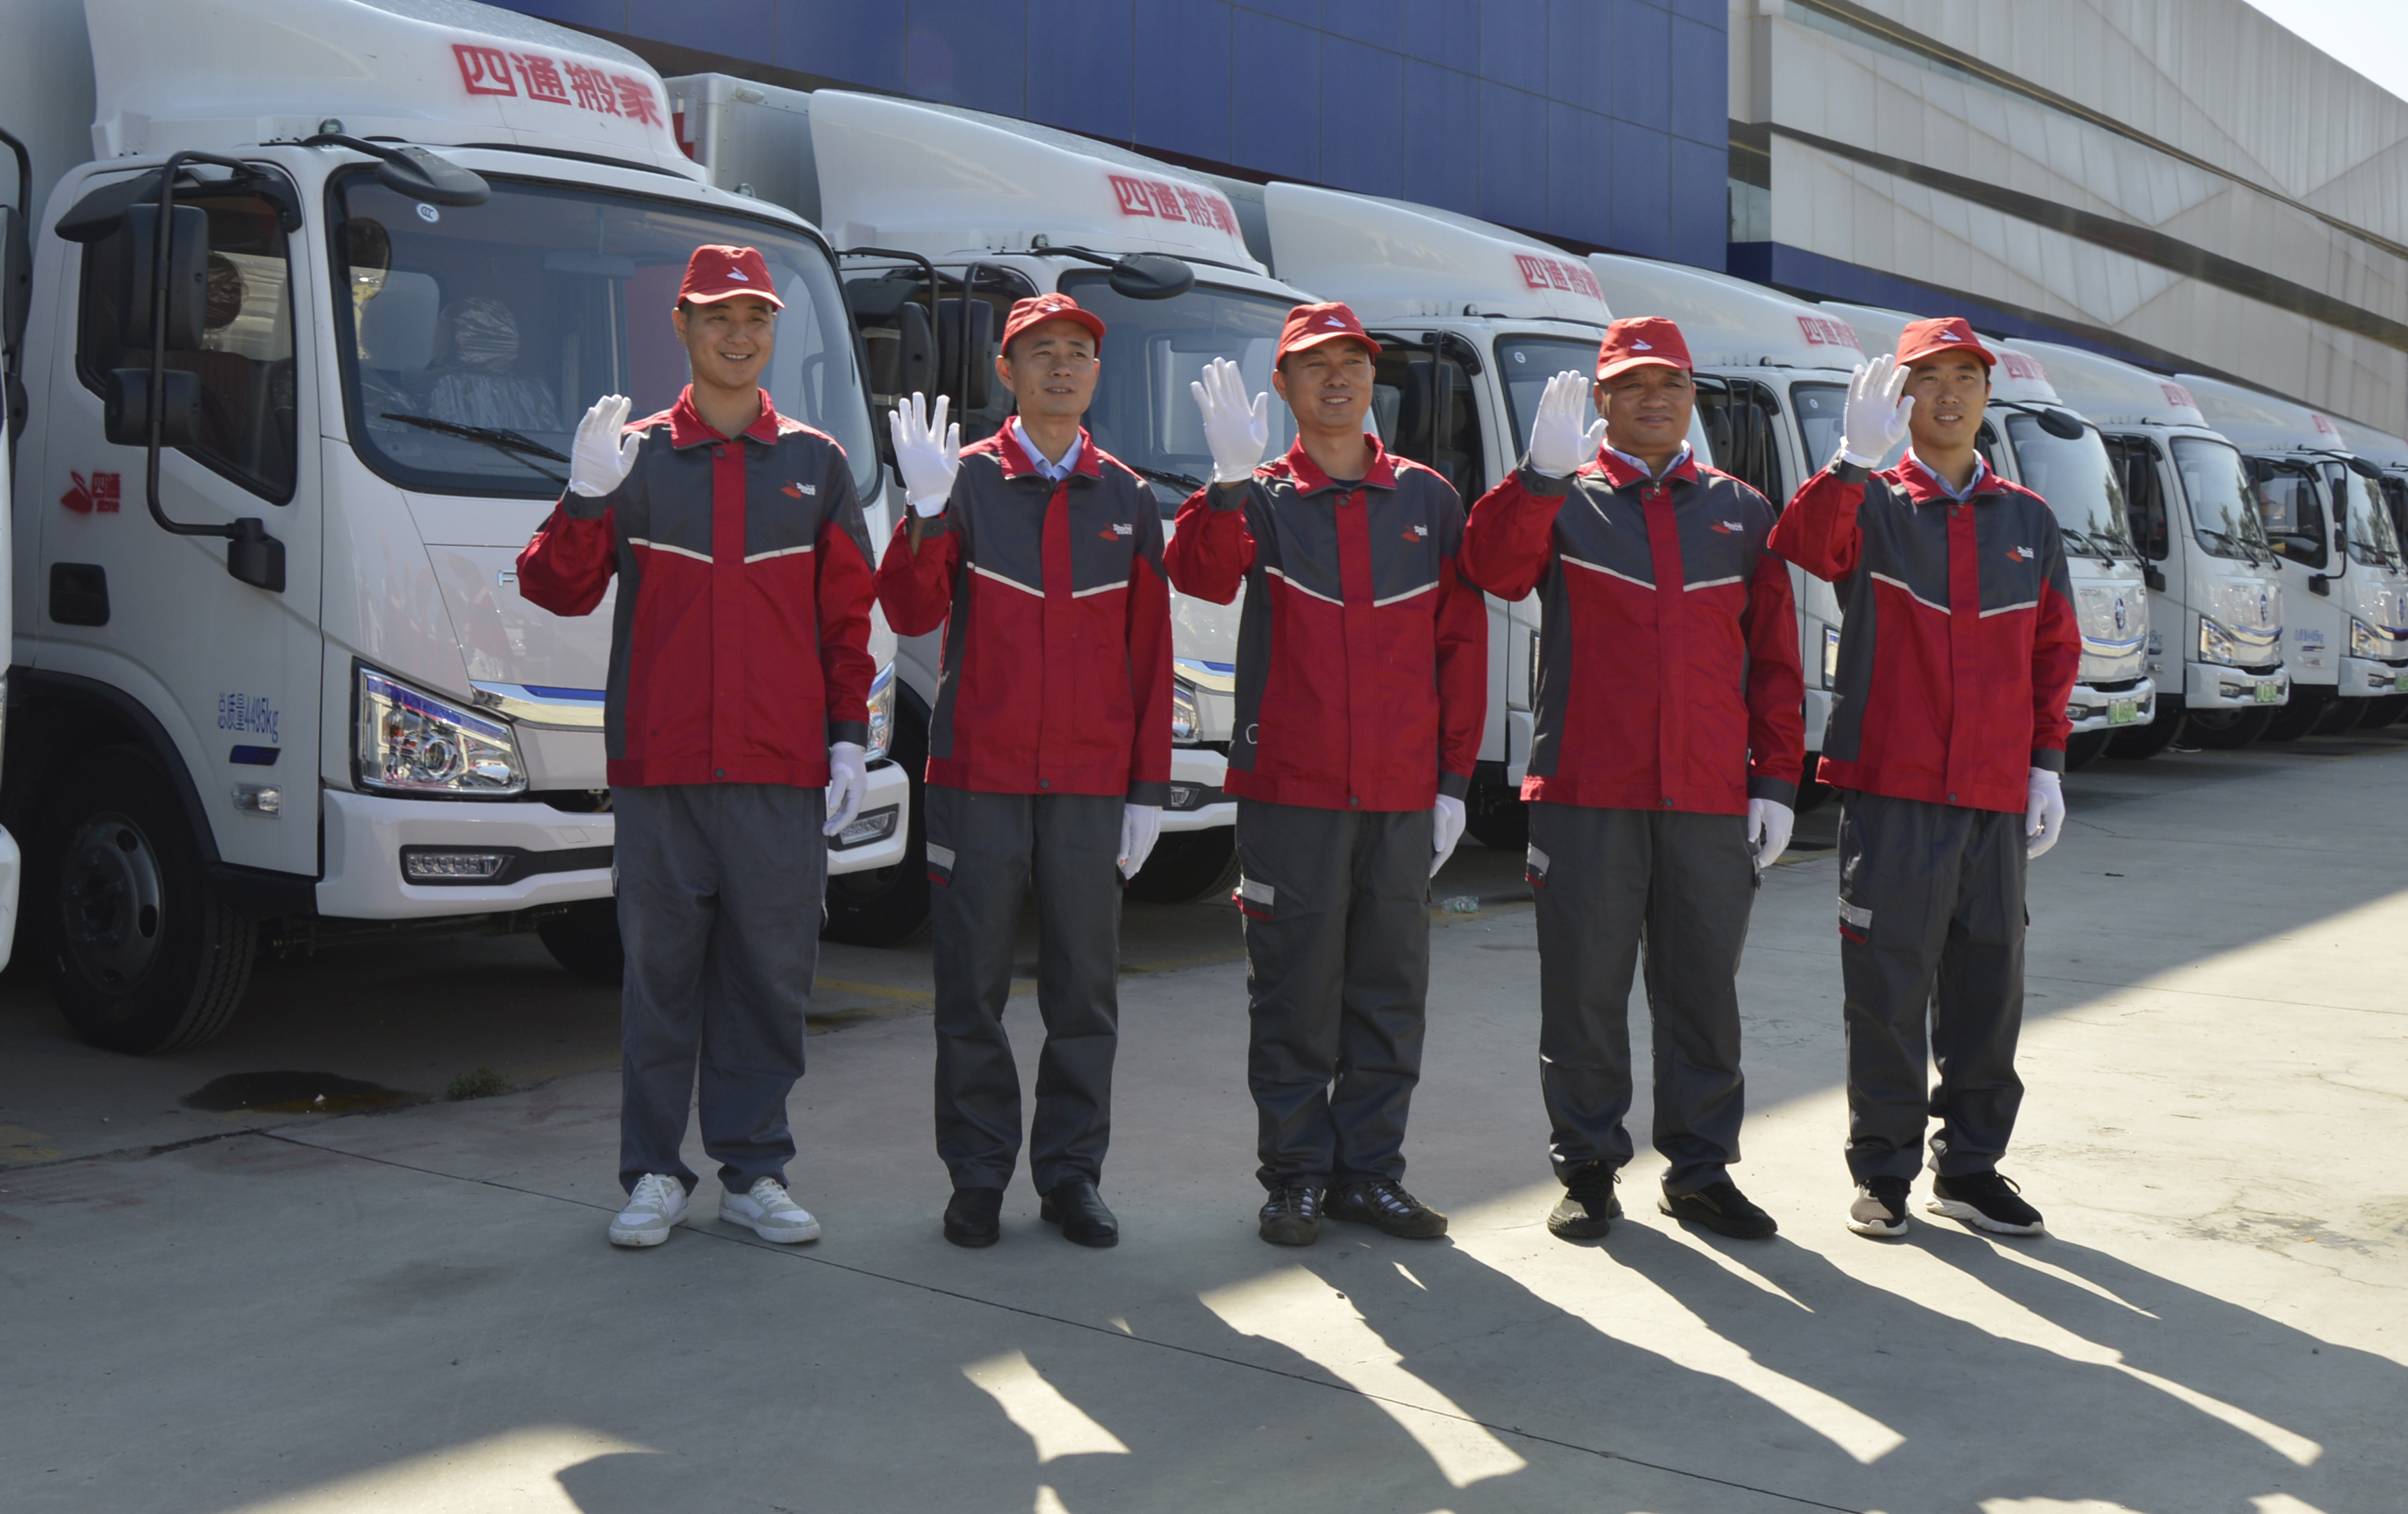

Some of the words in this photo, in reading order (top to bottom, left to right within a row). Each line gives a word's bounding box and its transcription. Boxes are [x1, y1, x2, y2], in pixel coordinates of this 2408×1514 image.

[452, 43, 663, 130] 四通搬家
[1108, 175, 1240, 236] 四通搬家
[218, 693, 279, 744] 总质量4495kg
